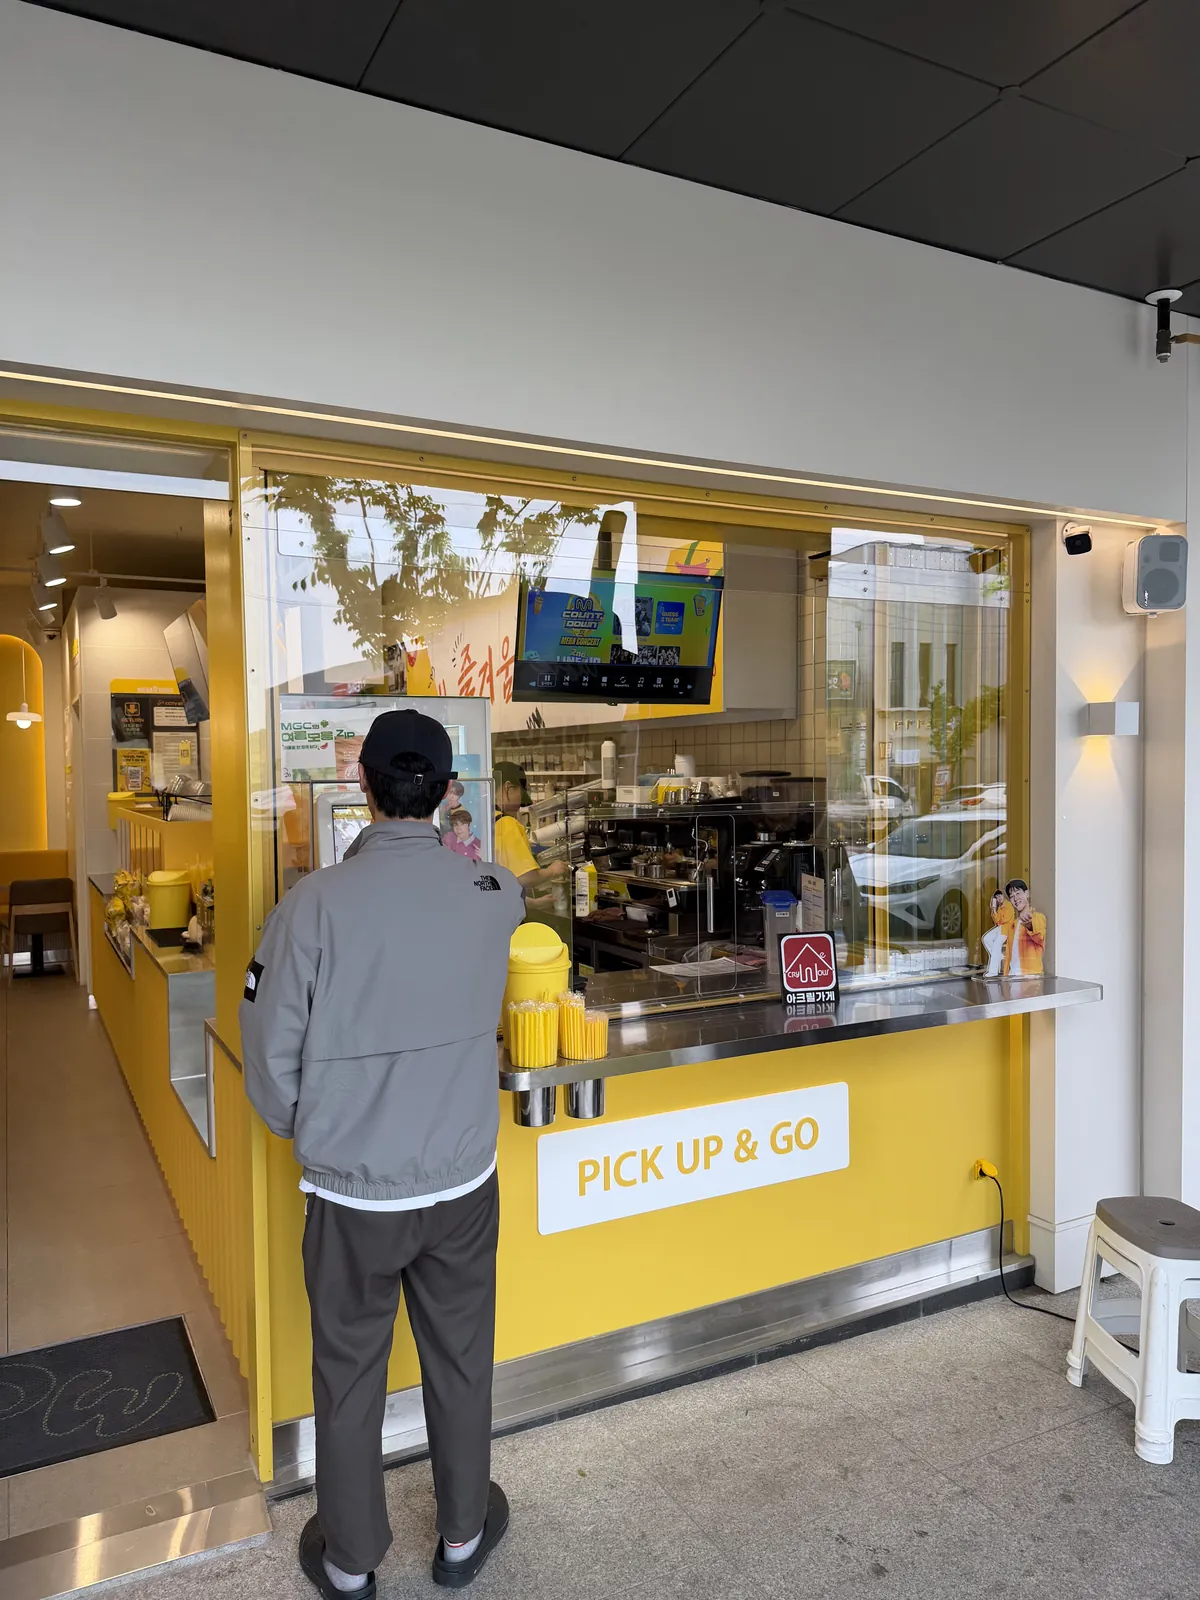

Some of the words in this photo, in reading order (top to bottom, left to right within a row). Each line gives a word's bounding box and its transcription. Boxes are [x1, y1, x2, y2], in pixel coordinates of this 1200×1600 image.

[566, 620, 597, 628] DOWN
[575, 637, 600, 646] CONCERT
[786, 990, 836, 1004] 아크릴가게
[578, 1144, 665, 1197] PICK
[676, 1134, 723, 1175] UP
[733, 1128, 759, 1163] &
[769, 1116, 820, 1155] GO
